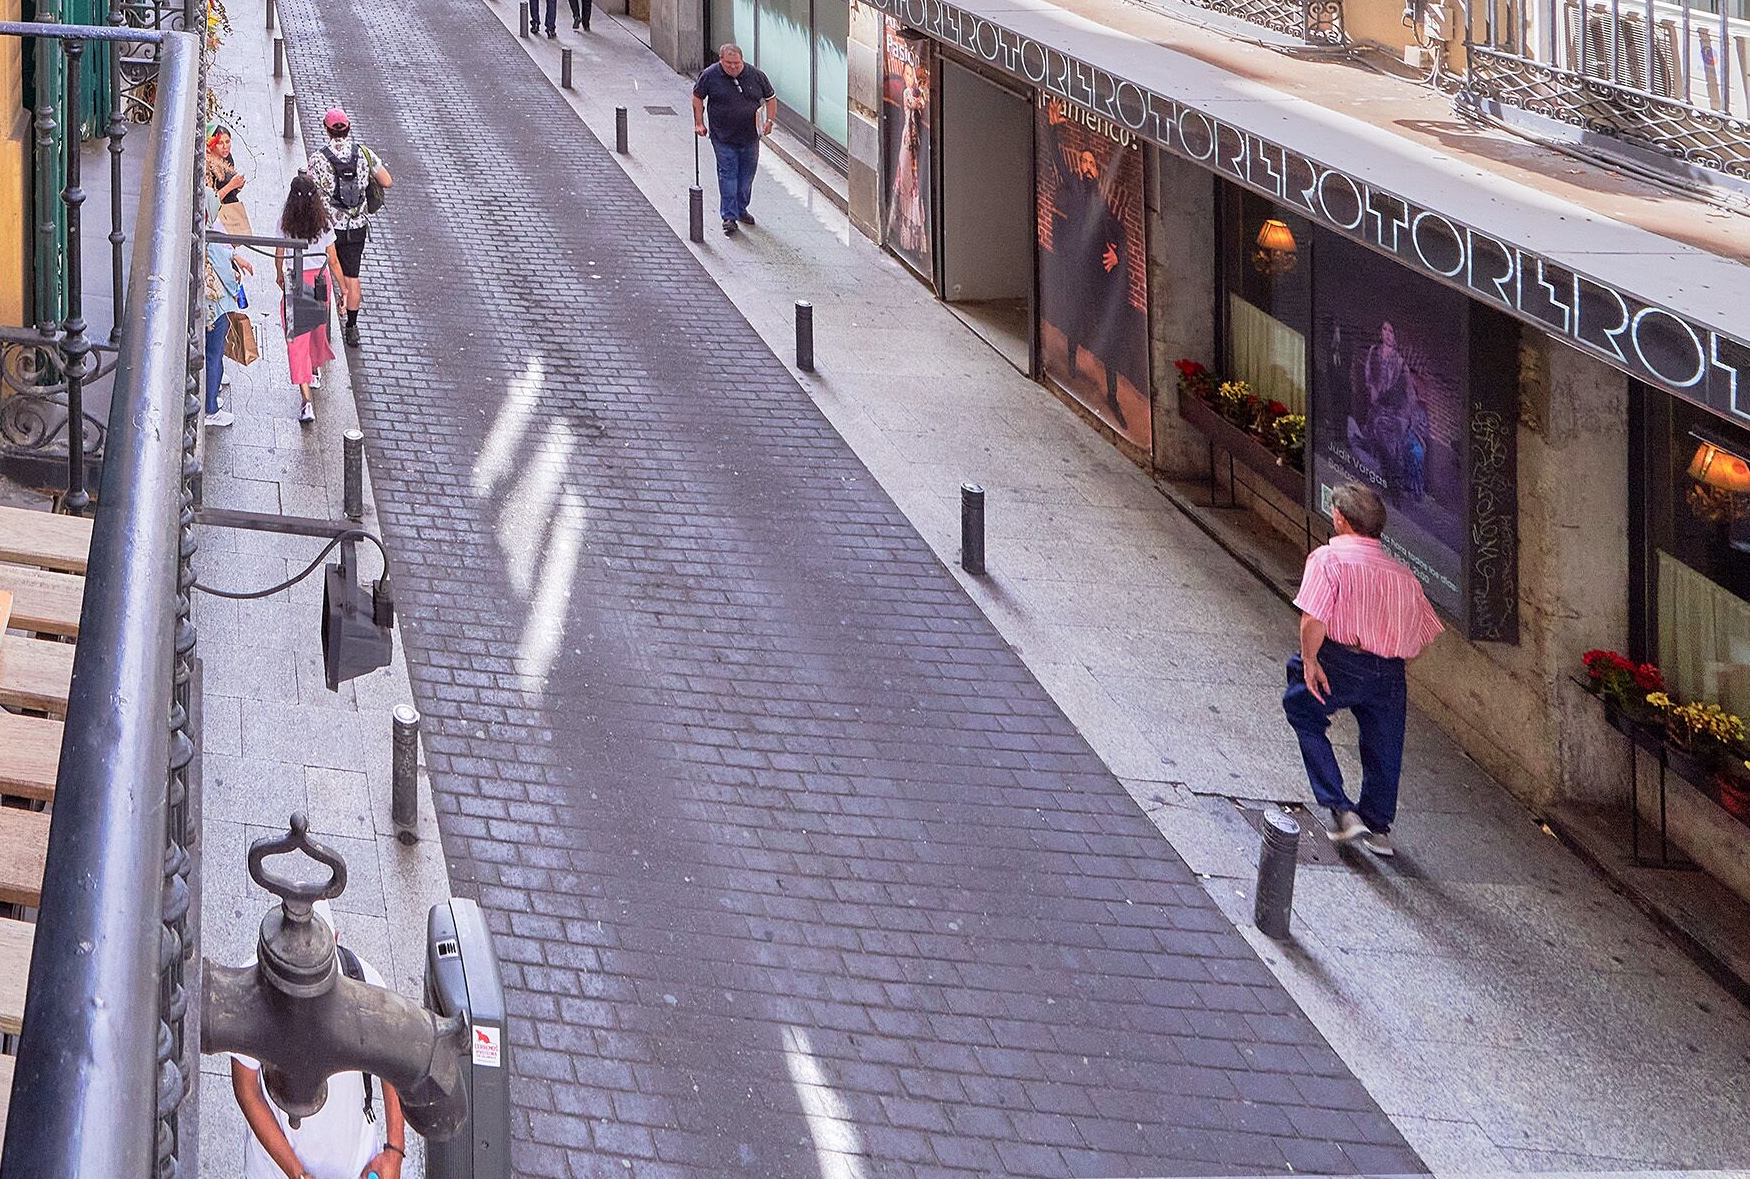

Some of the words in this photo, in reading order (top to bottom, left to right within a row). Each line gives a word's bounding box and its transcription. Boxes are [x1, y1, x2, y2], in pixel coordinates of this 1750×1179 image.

[1037, 87, 1138, 151] ¡Famenco!
[999, 26, 1146, 130] TORERO
[1147, 91, 1363, 230] TORERO
[1365, 183, 1706, 388] TORERO
[1328, 441, 1351, 464] Judit
[1352, 457, 1387, 489] Vargas
